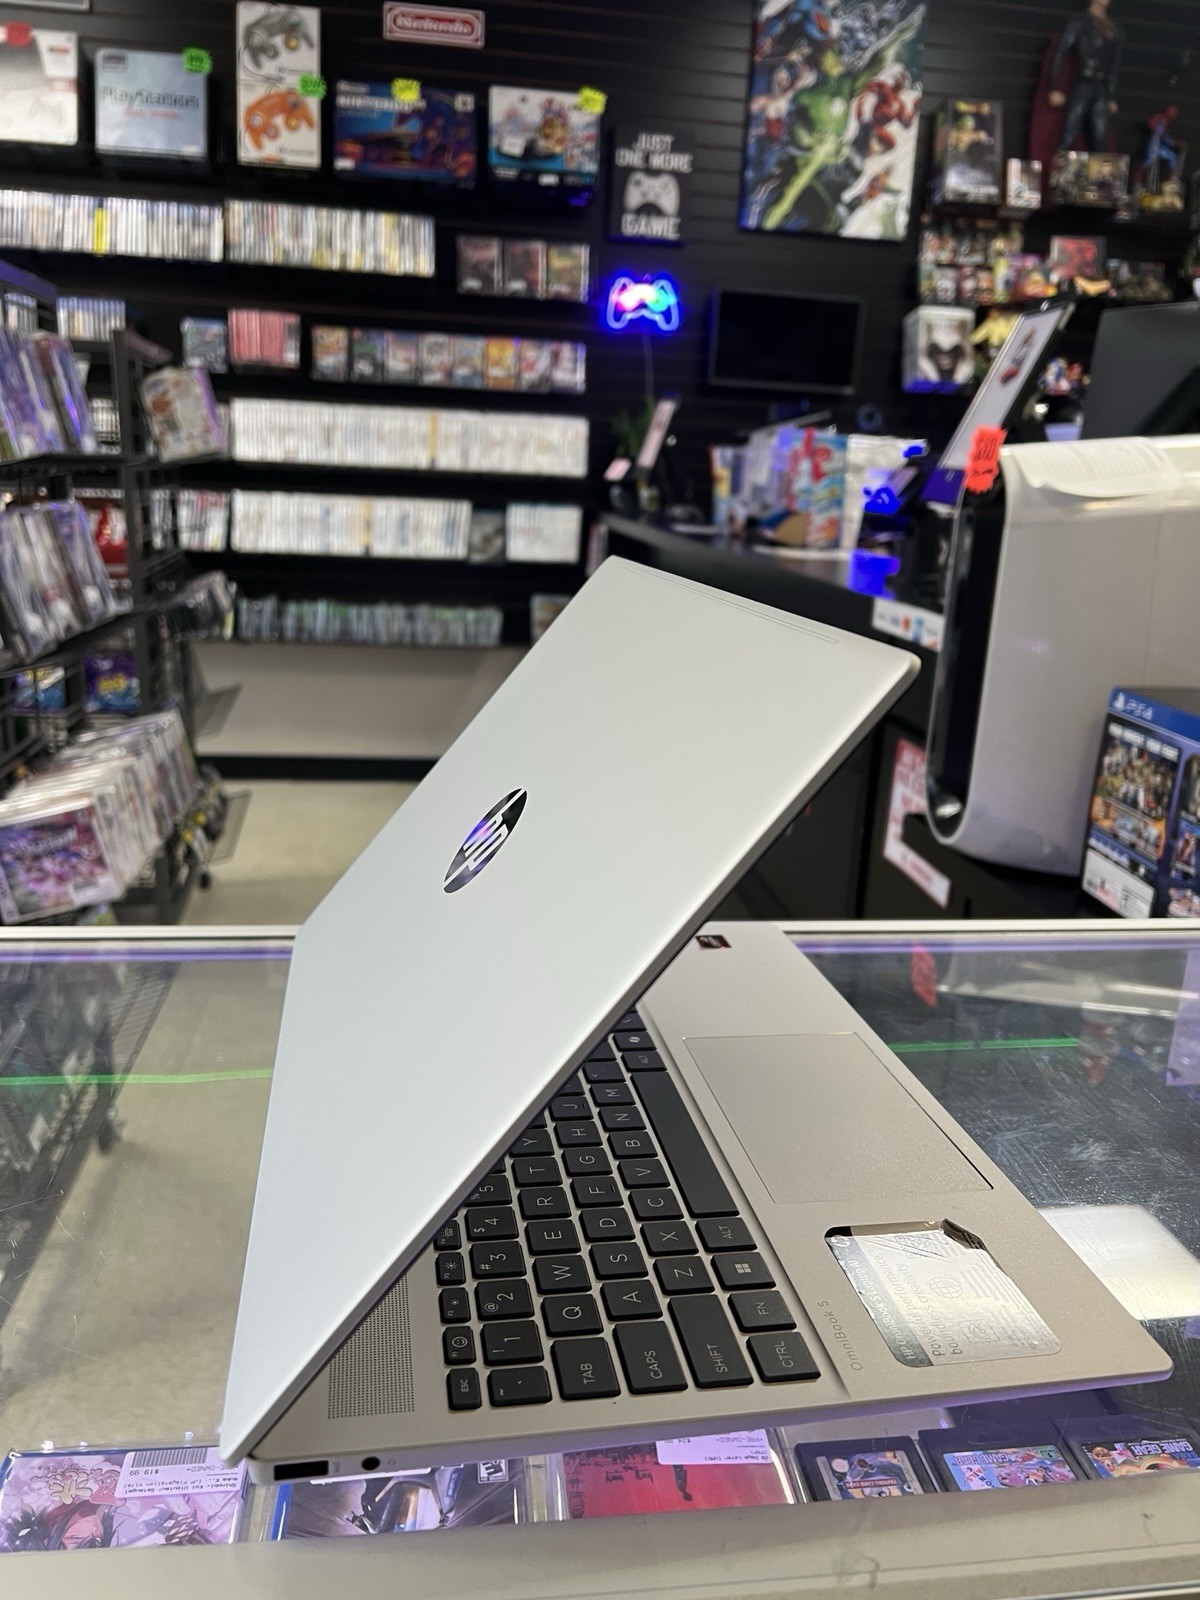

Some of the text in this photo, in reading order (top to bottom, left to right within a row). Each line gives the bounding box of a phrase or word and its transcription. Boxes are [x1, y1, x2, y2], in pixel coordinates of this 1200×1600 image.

[633, 133, 675, 153] JUST
[615, 147, 694, 174] ONE MORE
[621, 212, 681, 241] GAME
[1127, 700, 1153, 720] PS4
[606, 1088, 620, 1097] M
[614, 1113, 630, 1121] N
[571, 1128, 587, 1136] H
[522, 1138, 538, 1146] Y
[625, 1139, 641, 1148] B
[580, 1155, 595, 1164] G
[635, 1168, 651, 1177] V
[536, 1196, 554, 1206] R
[648, 1197, 664, 1208] C
[484, 1218, 500, 1226] 4
[600, 1218, 616, 1228] D
[544, 1230, 562, 1240] E
[660, 1231, 679, 1242] X
[719, 1226, 733, 1240] ALT
[610, 1253, 628, 1262] S
[552, 1264, 572, 1281] W
[674, 1268, 694, 1278] Z
[855, 1266, 878, 1296] Laptop
[496, 1292, 514, 1300] 2
[623, 1290, 642, 1303] A
[484, 1302, 499, 1312] @
[758, 1302, 770, 1315] FN
[874, 1252, 946, 1356] Powerful performance
[562, 1306, 582, 1320] Q
[878, 1301, 908, 1346] OmniBook
[924, 1304, 963, 1355] boundless
[826, 1312, 862, 1371] OmniBook
[708, 1344, 728, 1373] SHIFT
[775, 1340, 794, 1368] CTRL
[900, 1346, 916, 1359] HP
[644, 1350, 663, 1379] CAPS
[580, 1363, 596, 1384] TAB
[461, 1378, 470, 1392] ESC
[1130, 1444, 1162, 1456] GEAR
[1160, 1441, 1194, 1453] GAME
[954, 1454, 1009, 1466] GAME GEAR
[129, 1468, 159, 1476] $1999
